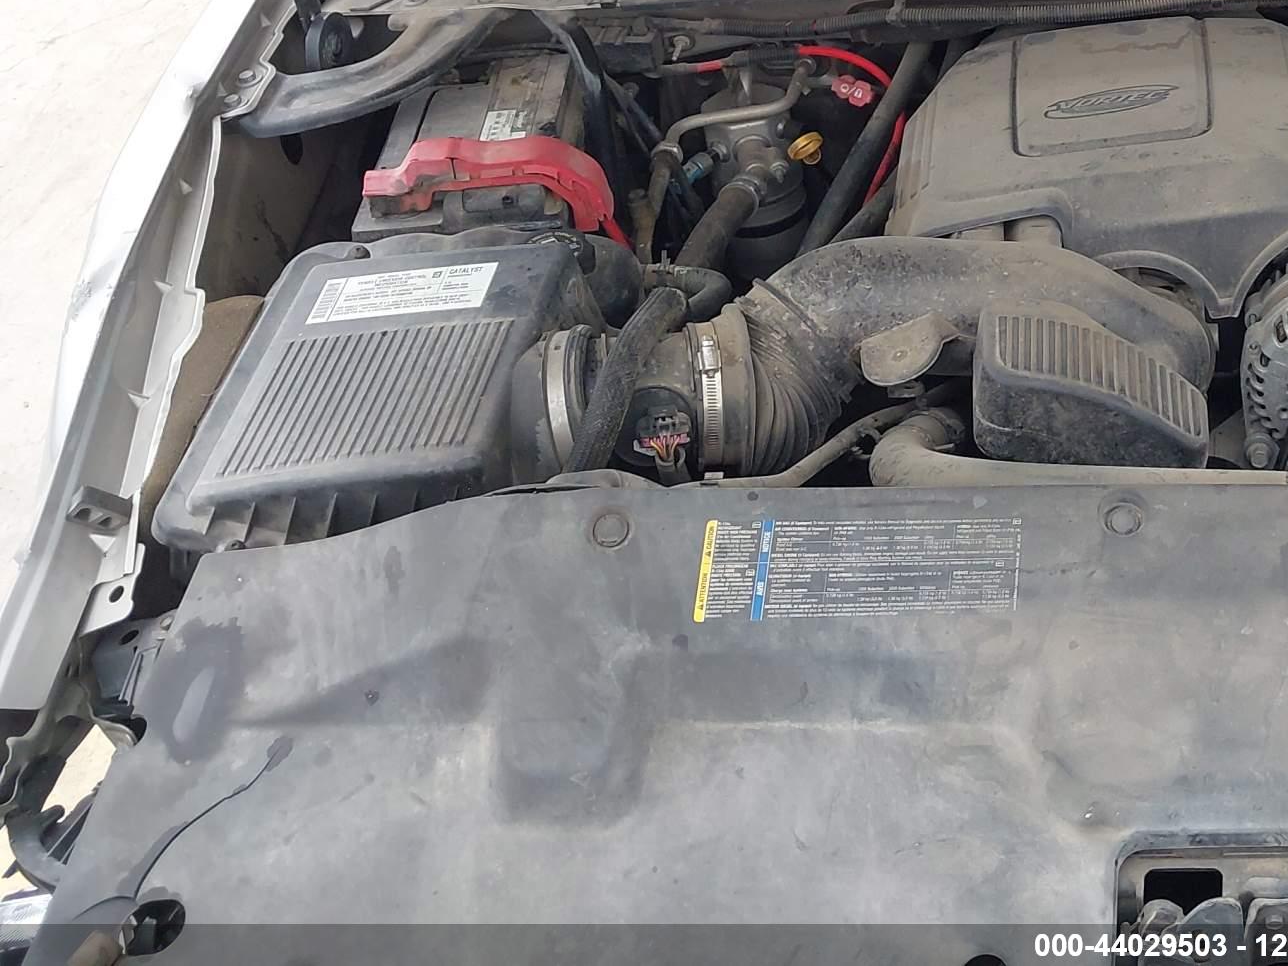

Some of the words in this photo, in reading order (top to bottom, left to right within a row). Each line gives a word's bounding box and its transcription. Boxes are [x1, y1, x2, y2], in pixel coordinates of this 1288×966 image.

[449, 266, 484, 275] CATALYST
[705, 526, 715, 551] CAUTION
[762, 531, 772, 553] NOTICE
[698, 572, 709, 606] ATTENTION
[756, 581, 765, 596] AVIS
